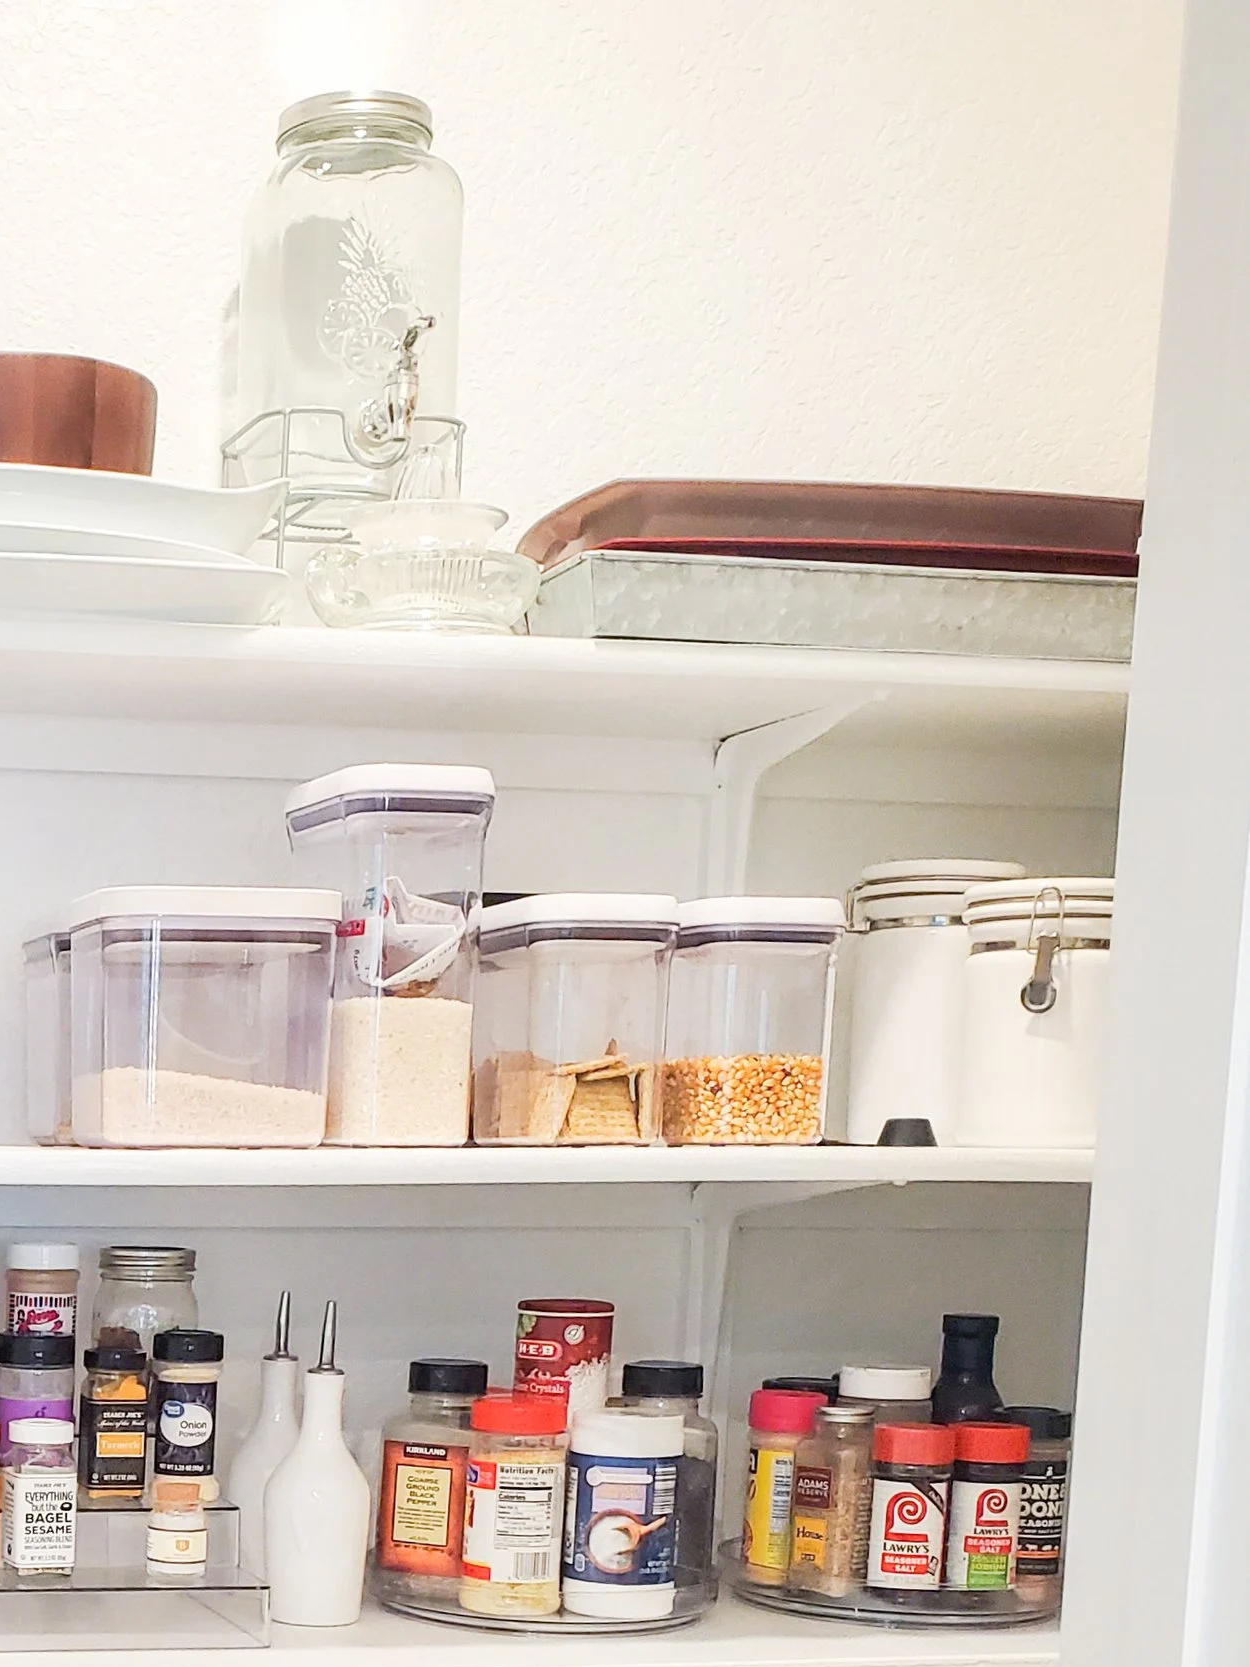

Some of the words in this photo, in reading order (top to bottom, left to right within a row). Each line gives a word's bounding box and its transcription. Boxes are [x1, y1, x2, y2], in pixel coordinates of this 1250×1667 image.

[180, 1420, 207, 1429] Onion
[406, 1446, 446, 1456] KIRKLAND
[499, 1467, 534, 1475] Nutrition
[406, 1483, 440, 1492] GROUND
[797, 1478, 829, 1490] ADAMS
[25, 1491, 74, 1502] EVERYTHING
[409, 1491, 435, 1499] BLACK
[25, 1512, 72, 1524] BAGEL
[25, 1525, 72, 1535] SESAME
[883, 1542, 930, 1553] LAWRY'S
[979, 1545, 1001, 1553] SALT
[884, 1555, 928, 1565] SEASONED
[895, 1564, 916, 1573] SALT
